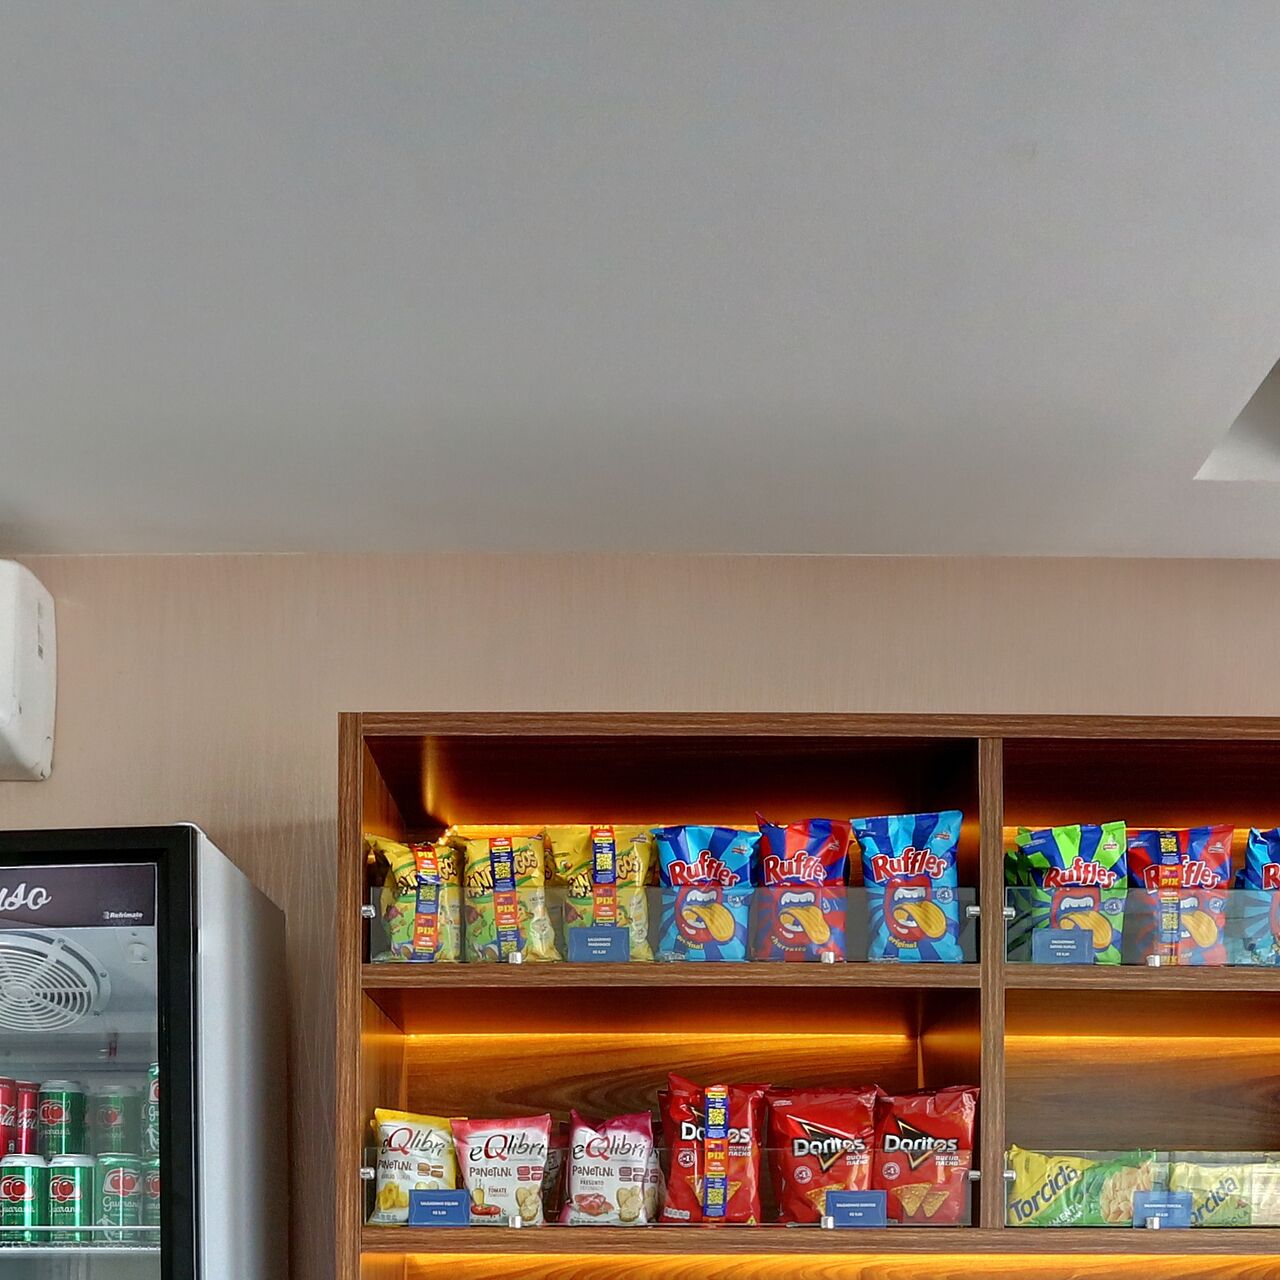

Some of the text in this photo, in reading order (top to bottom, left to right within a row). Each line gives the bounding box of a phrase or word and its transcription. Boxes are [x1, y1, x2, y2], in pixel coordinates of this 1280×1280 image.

[418, 851, 434, 859] PIX
[668, 849, 740, 888] Ruffles
[870, 847, 947, 883] Ruffles
[1043, 856, 1117, 890] Ruffles
[1161, 878, 1178, 886] PIX
[496, 905, 515, 913] PIX
[596, 896, 614, 905] PIX
[417, 926, 434, 935] PIX
[793, 1137, 866, 1158] Doritos
[884, 1134, 959, 1153] Doritos
[707, 1151, 725, 1161] PIX
[1009, 1164, 1080, 1223] Torcida
[1191, 1175, 1240, 1224] orcida
